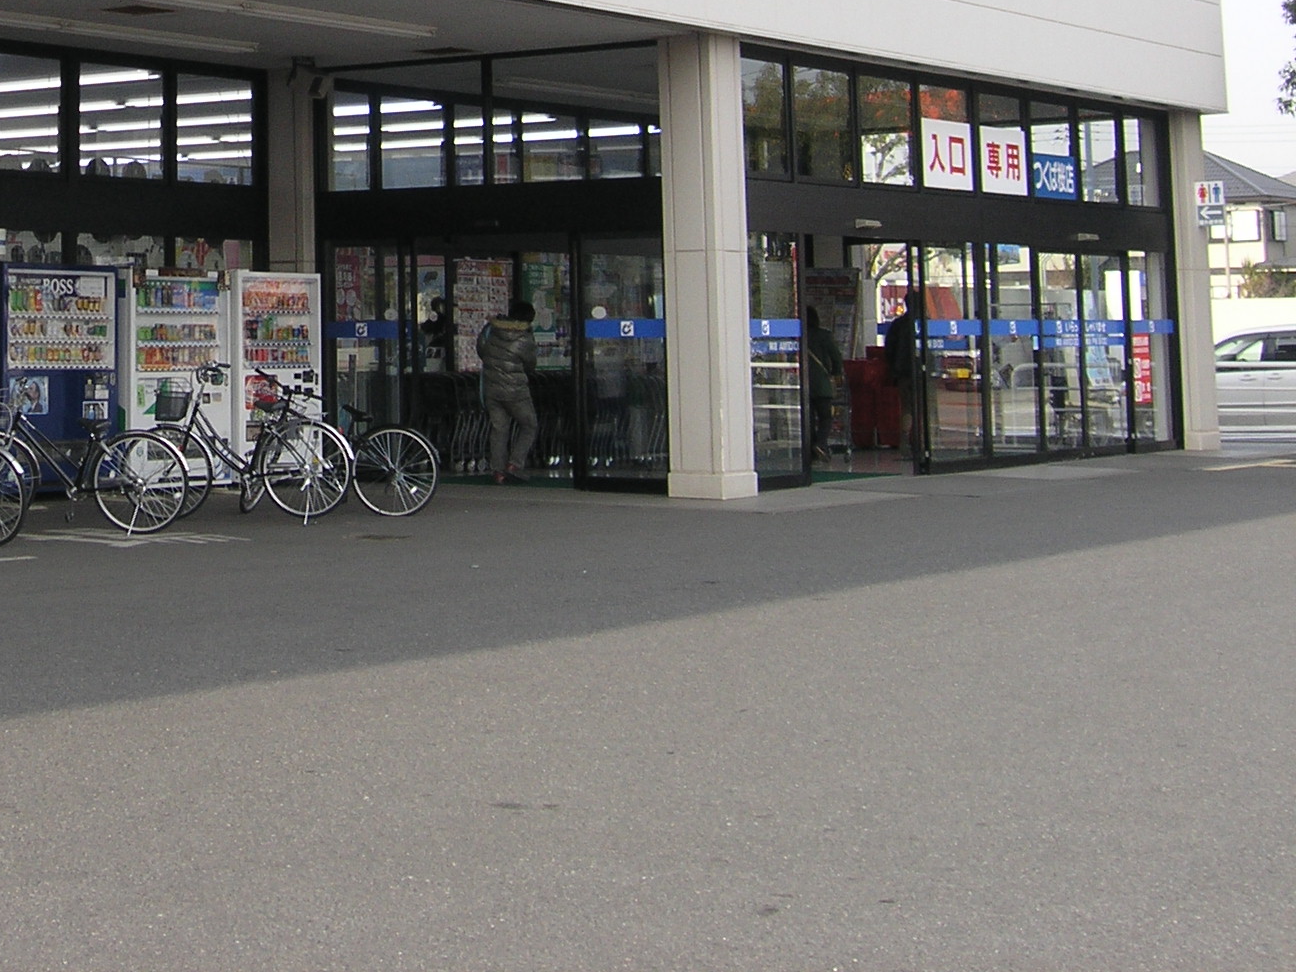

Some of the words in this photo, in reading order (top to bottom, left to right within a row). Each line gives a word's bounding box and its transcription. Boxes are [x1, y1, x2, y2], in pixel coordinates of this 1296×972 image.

[929, 133, 966, 176] 入口
[986, 141, 1021, 181] 専用
[43, 278, 74, 295] BOSS
